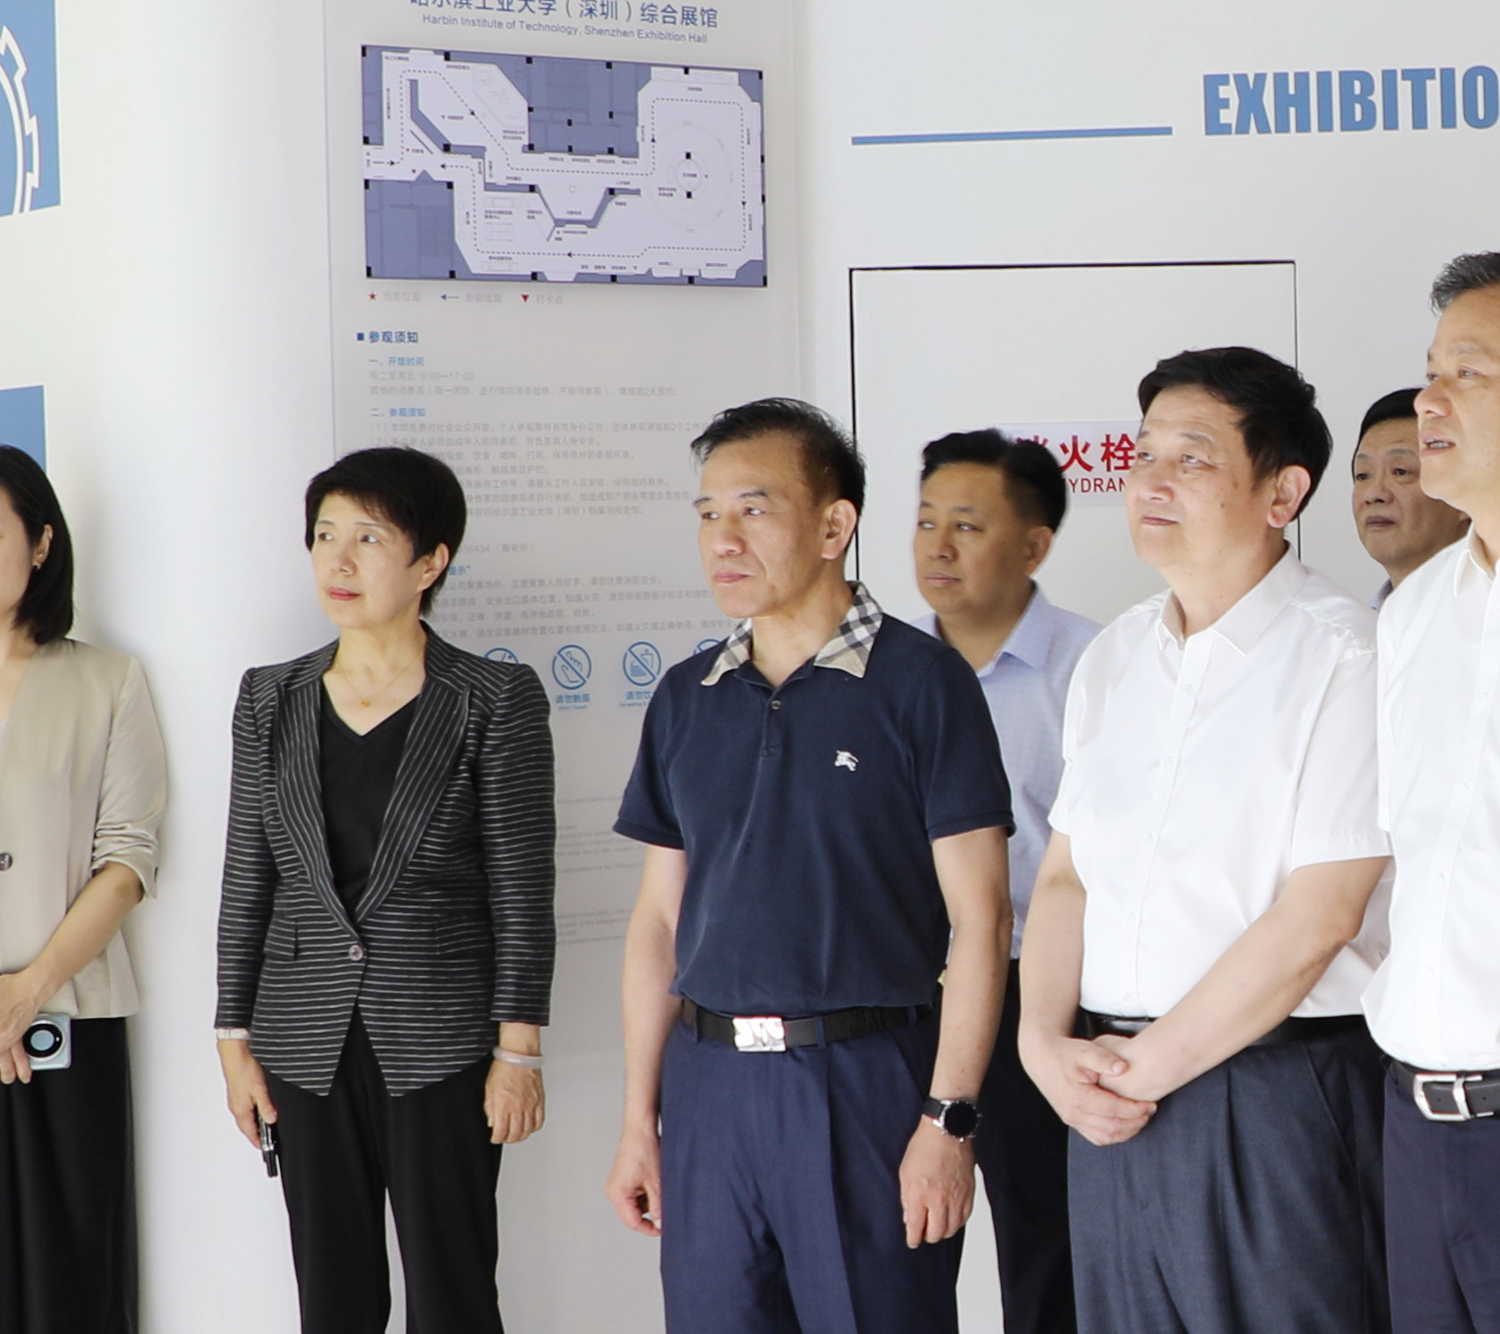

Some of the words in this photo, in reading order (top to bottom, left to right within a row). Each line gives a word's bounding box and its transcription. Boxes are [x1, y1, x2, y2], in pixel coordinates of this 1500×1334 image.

[423, 13, 458, 26] Harbin
[461, 16, 503, 29] Institute
[506, 19, 516, 30] of
[519, 20, 582, 37] Technology,
[585, 25, 635, 39] Shenzhen
[637, 29, 686, 42] Exhibition
[688, 32, 708, 44] Hall
[369, 331, 419, 344] 参观须知
[1016, 433, 1136, 472] 火栓
[1062, 477, 1126, 493] YDRAN
